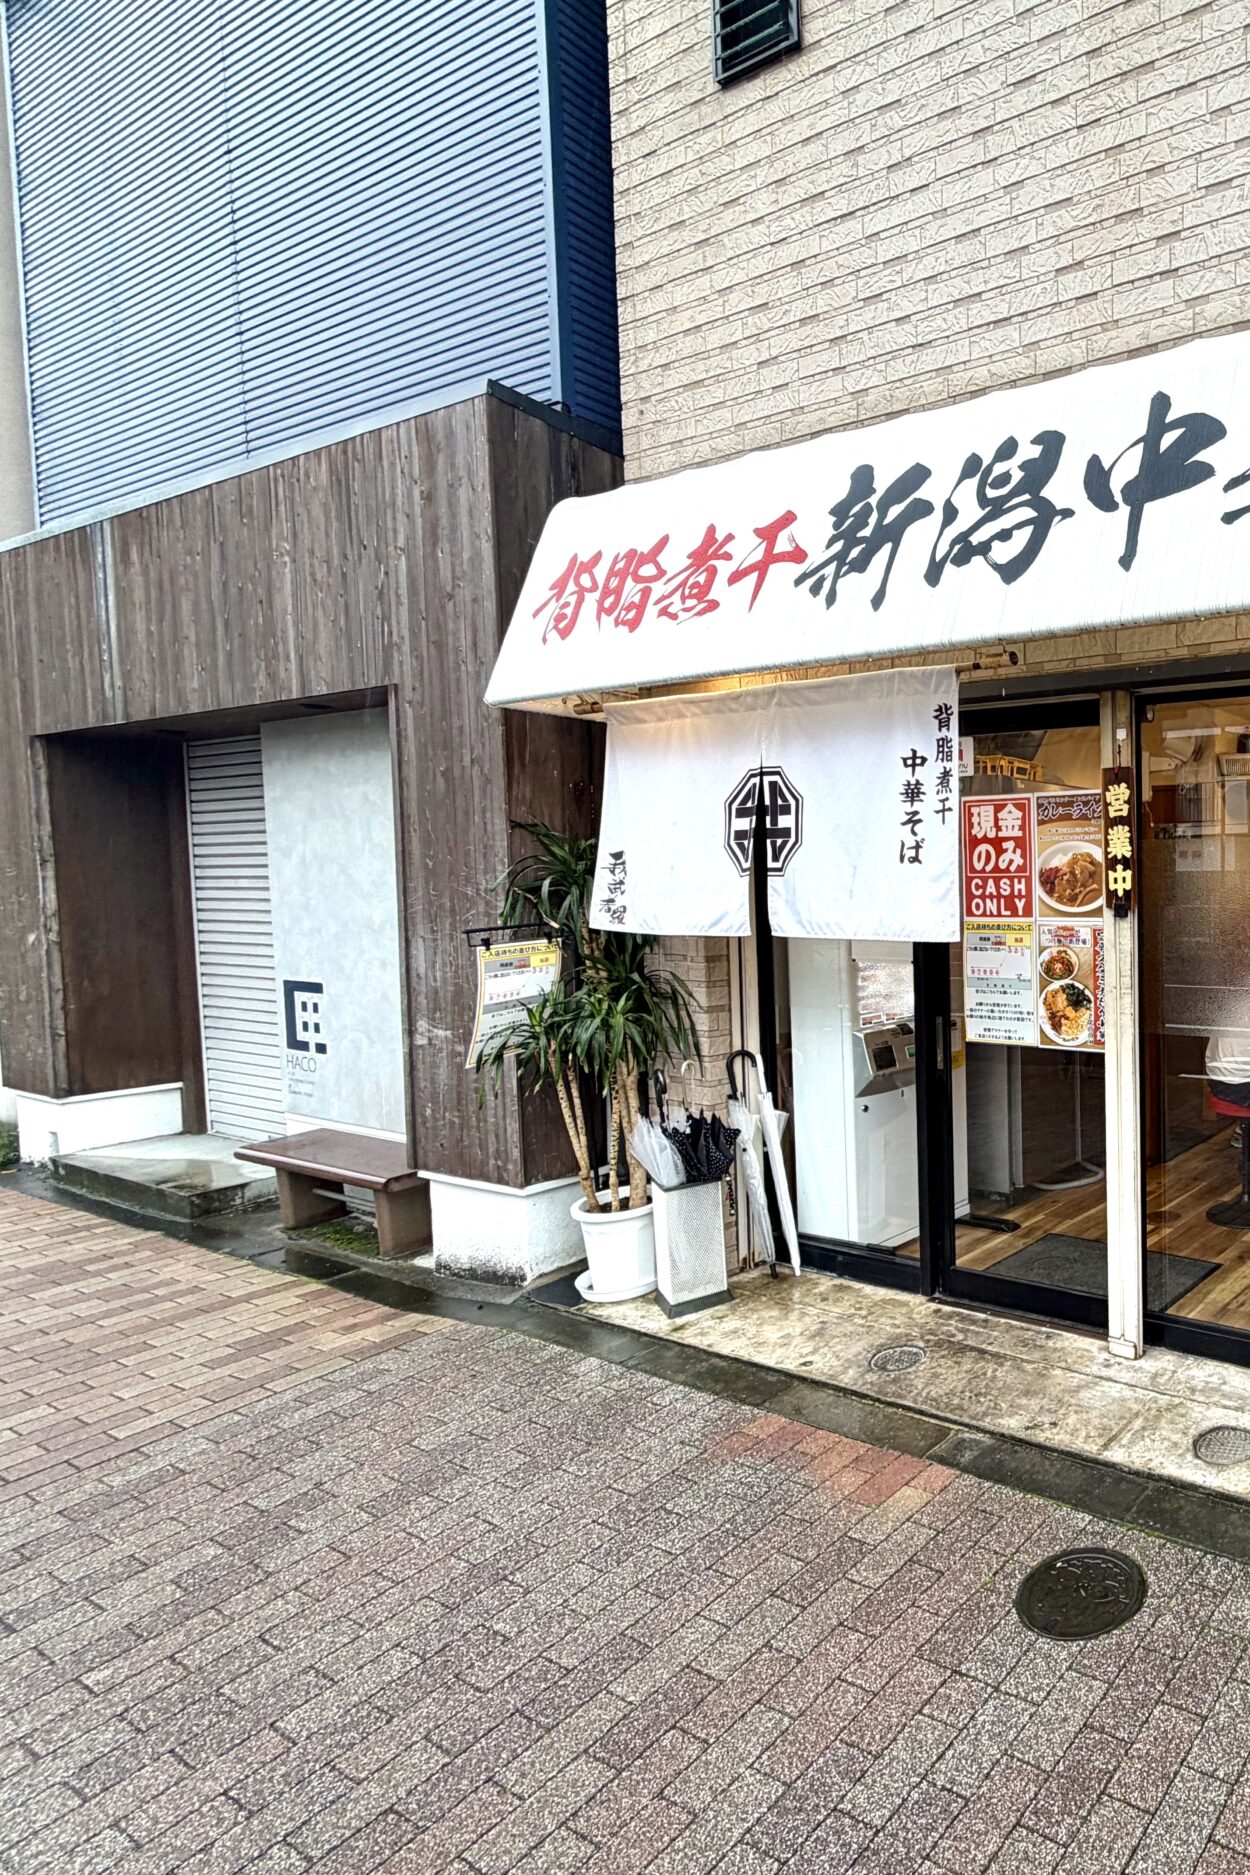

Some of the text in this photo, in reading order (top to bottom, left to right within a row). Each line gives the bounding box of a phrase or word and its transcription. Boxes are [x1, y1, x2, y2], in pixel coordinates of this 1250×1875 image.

[532, 509, 811, 645] 背脂煮干
[931, 702, 955, 825] 背脂煮干
[899, 748, 928, 865] 中華そば
[971, 803, 1023, 839] 現金
[972, 841, 1025, 873] のみ
[1106, 782, 1133, 898] 営業中
[971, 878, 1026, 896] CASH
[971, 897, 1027, 917] ONLY
[286, 1054, 316, 1072] HACO
